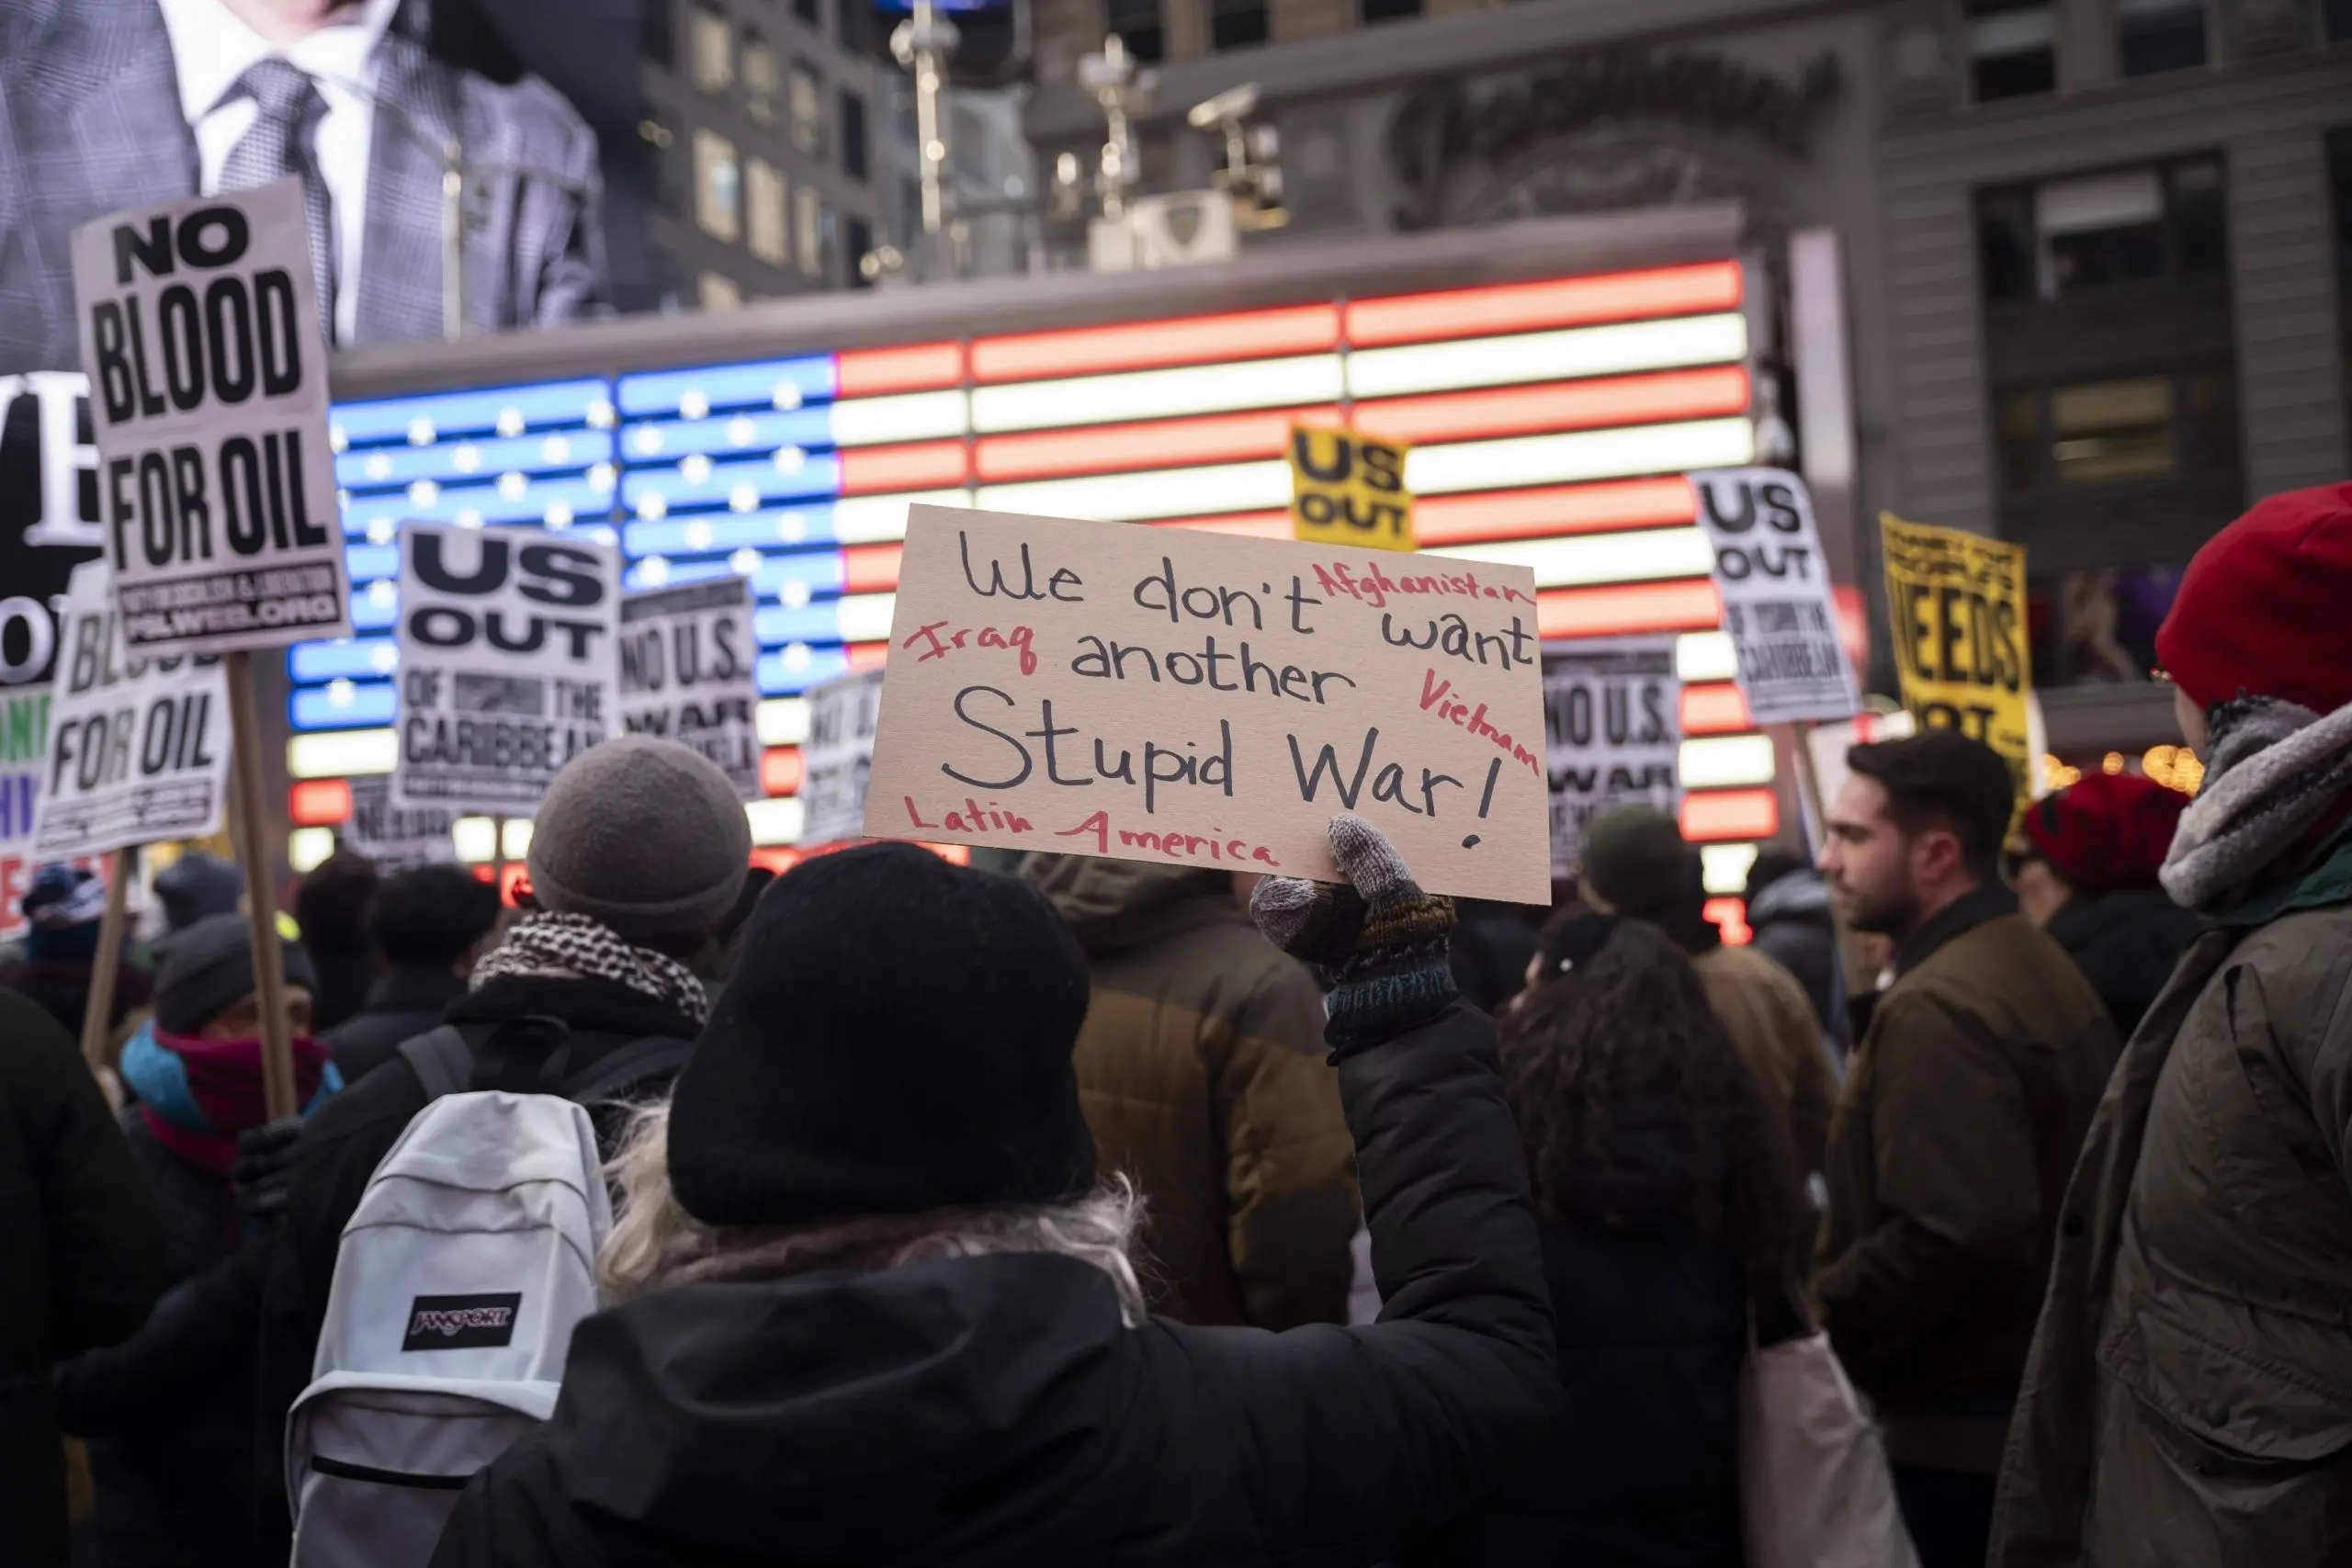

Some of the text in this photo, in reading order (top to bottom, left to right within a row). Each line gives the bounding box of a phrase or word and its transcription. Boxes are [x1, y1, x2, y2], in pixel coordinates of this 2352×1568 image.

[112, 207, 249, 284] NO
[91, 265, 300, 423] BLOOD
[1295, 433, 1400, 491] US
[109, 430, 328, 572] FOR OIL
[1299, 493, 1405, 538] OUT
[1702, 482, 1801, 533] US
[412, 533, 605, 606] US
[1312, 561, 1537, 608] Afghanistan
[1718, 546, 1809, 581] OUT
[409, 607, 605, 660] OUT
[959, 530, 1535, 671] We don't want
[902, 621, 1038, 676] Iraq
[1071, 636, 1356, 705] another
[51, 708, 136, 795] FOR
[141, 694, 213, 776] OIL
[1419, 668, 1540, 778] Vietnam
[941, 685, 1502, 850] Stupid War!
[903, 795, 1035, 834] Latin
[1054, 810, 1281, 866] America
[411, 1307, 512, 1337] JANSPORT
